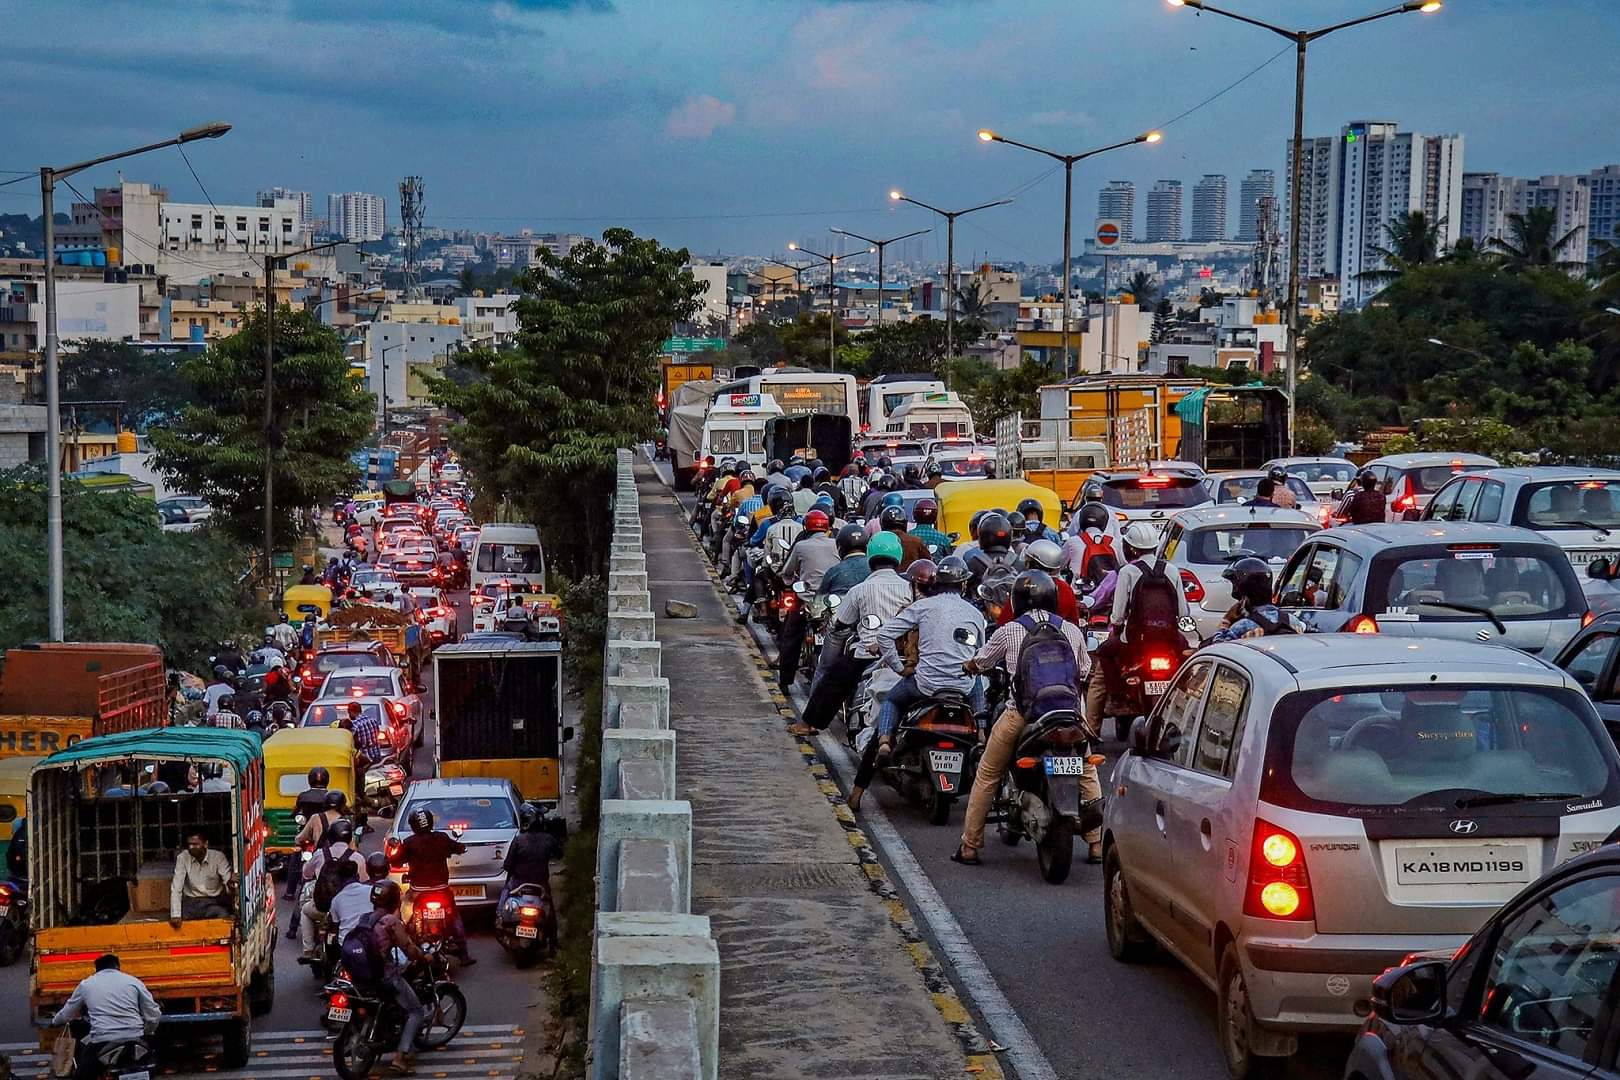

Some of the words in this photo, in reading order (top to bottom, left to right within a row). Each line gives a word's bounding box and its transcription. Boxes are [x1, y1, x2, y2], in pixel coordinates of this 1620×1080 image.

[1054, 758, 1064, 766] KA
[1068, 758, 1077, 766] 19
[1061, 766, 1081, 774] 1456
[940, 774, 954, 791] L
